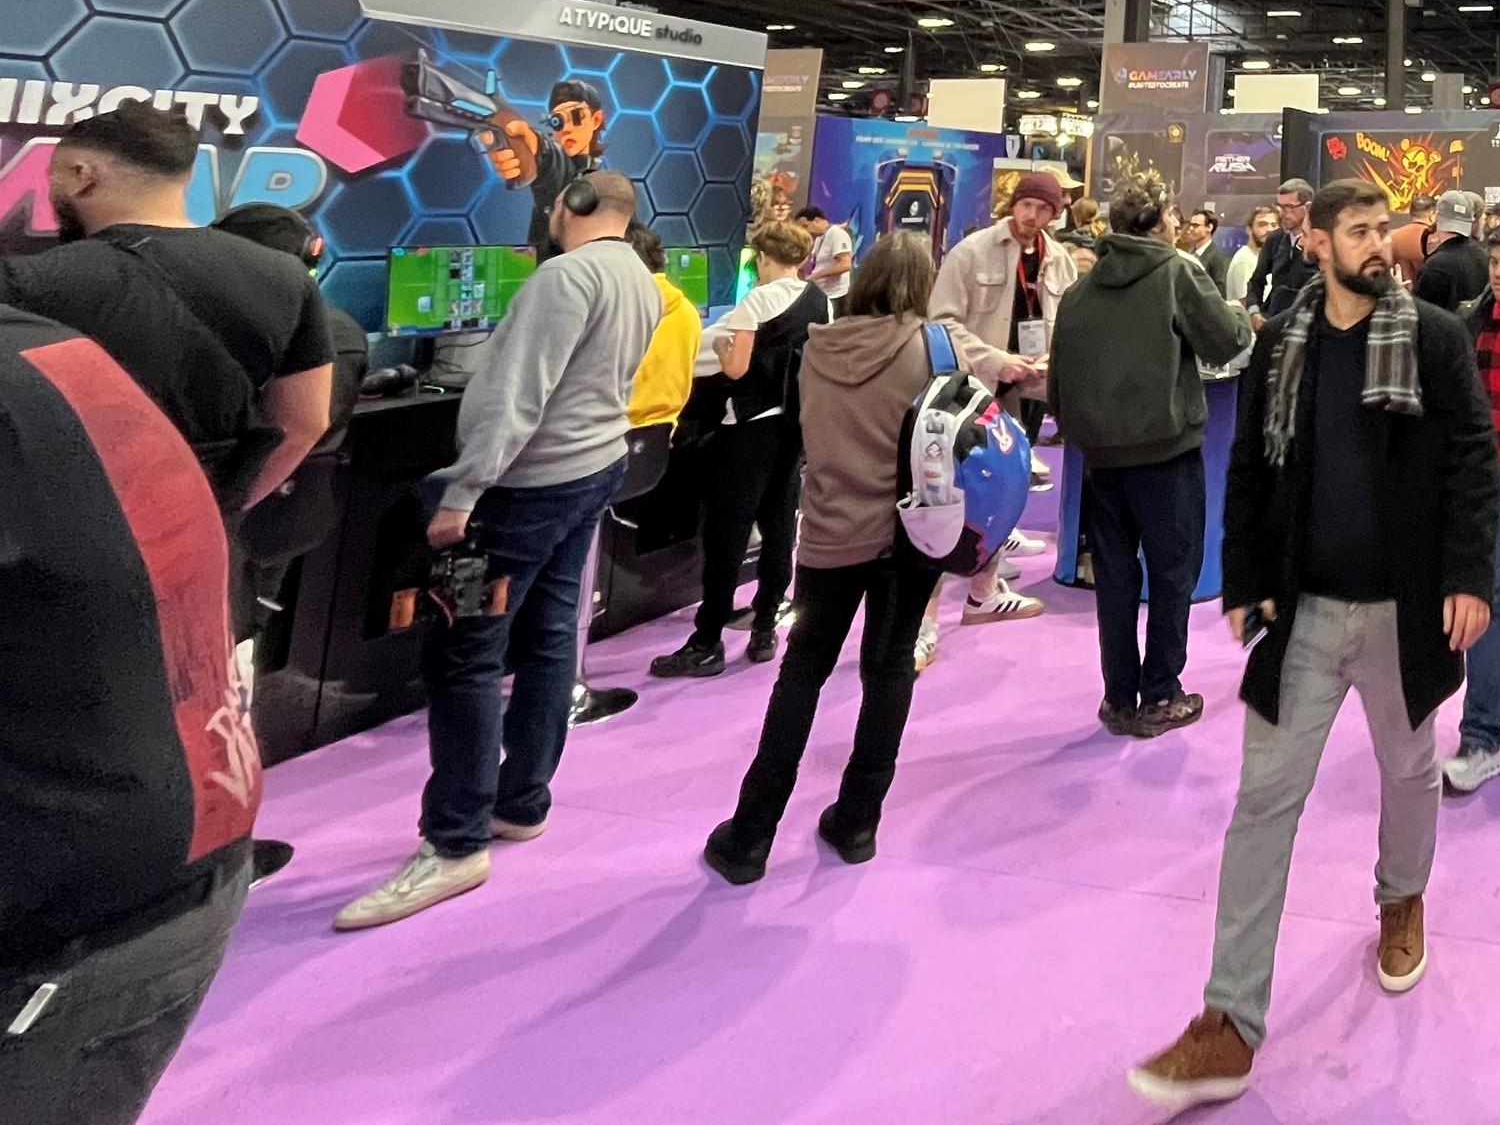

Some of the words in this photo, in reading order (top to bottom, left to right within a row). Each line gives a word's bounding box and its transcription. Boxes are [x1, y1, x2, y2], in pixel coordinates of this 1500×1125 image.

[655, 25, 703, 45] studio
[1355, 131, 1391, 162] BOOM!
[1208, 162, 1257, 173] RUSH
